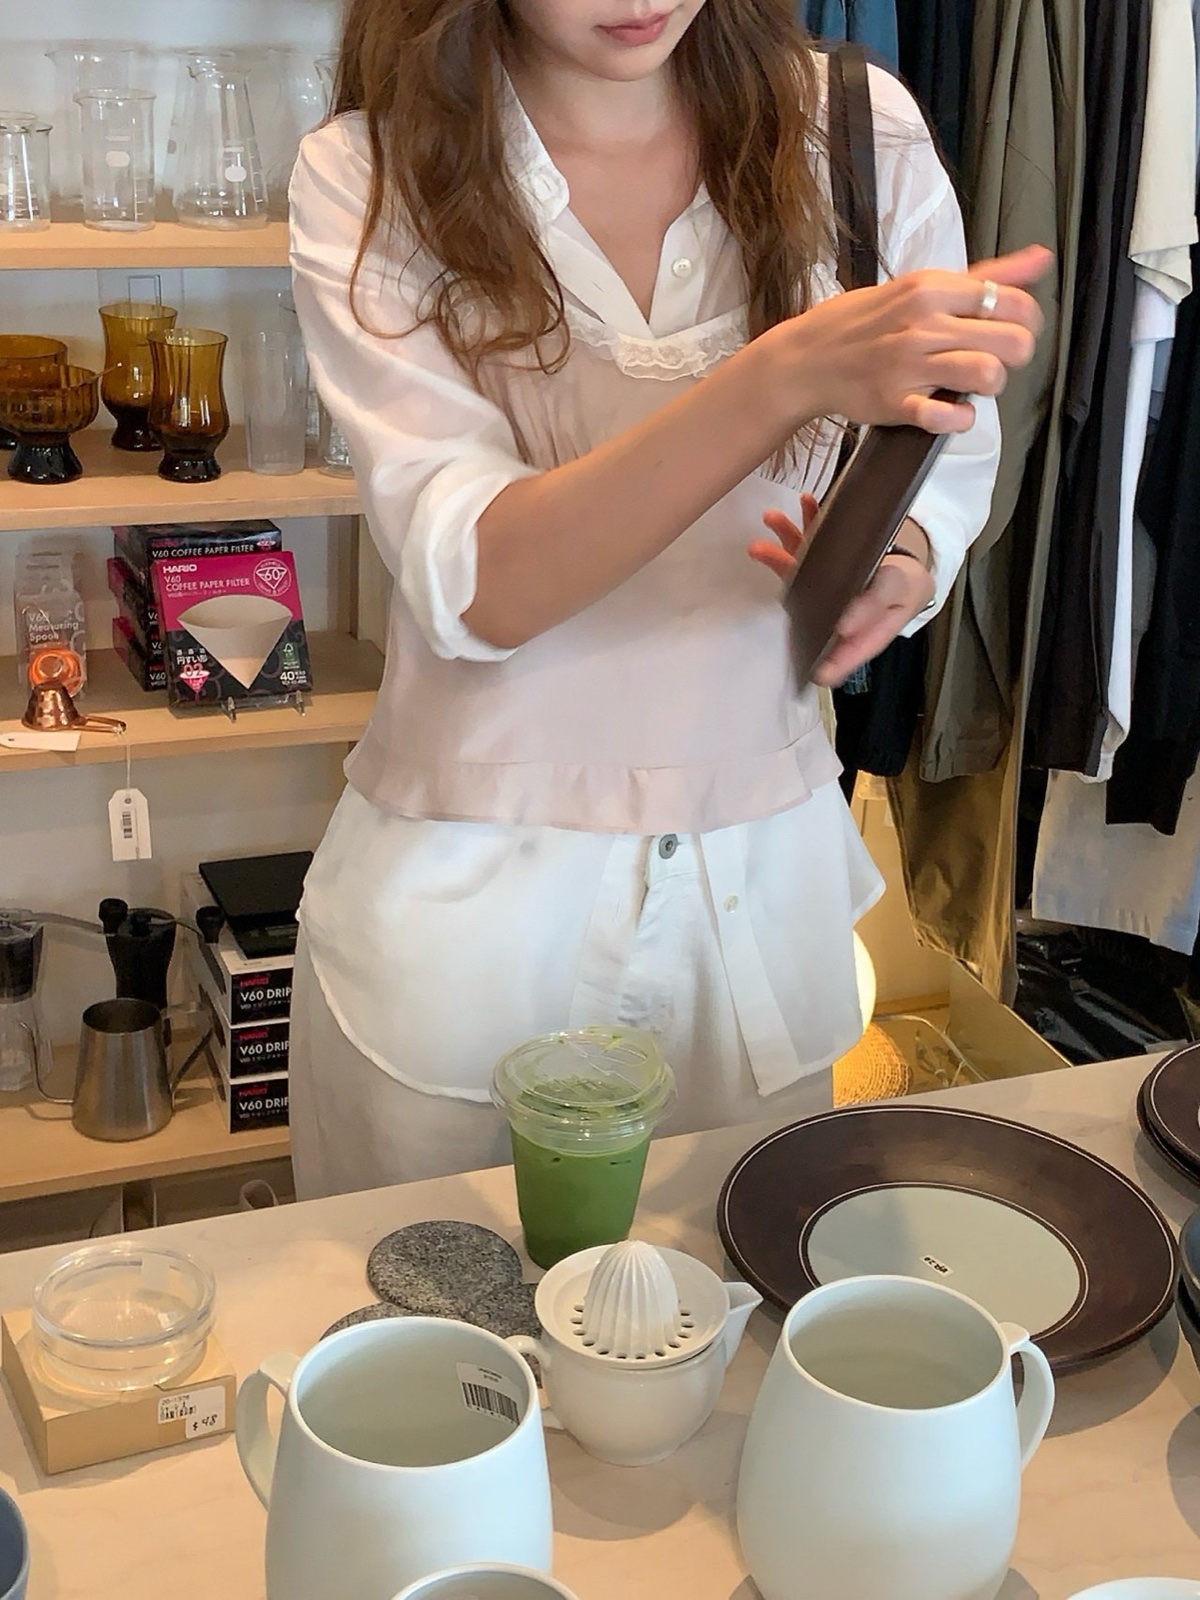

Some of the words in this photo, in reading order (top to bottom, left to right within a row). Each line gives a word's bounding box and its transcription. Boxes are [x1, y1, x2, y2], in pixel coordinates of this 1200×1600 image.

[152, 550, 169, 558] V60
[171, 547, 202, 558] COFFEE
[204, 546, 229, 555] PAPER
[231, 544, 255, 553] FILTER
[162, 563, 198, 574] HARIO
[164, 575, 181, 583] V60
[166, 582, 198, 593] COFFEE
[200, 580, 225, 590] PAPER
[226, 578, 250, 588] FILTER
[28, 622, 79, 632] Meauring
[280, 671, 294, 681] 40
[240, 990, 264, 1002] V60
[266, 987, 292, 999] DRIP
[240, 1044, 263, 1056] V60
[239, 1100, 263, 1111] V60
